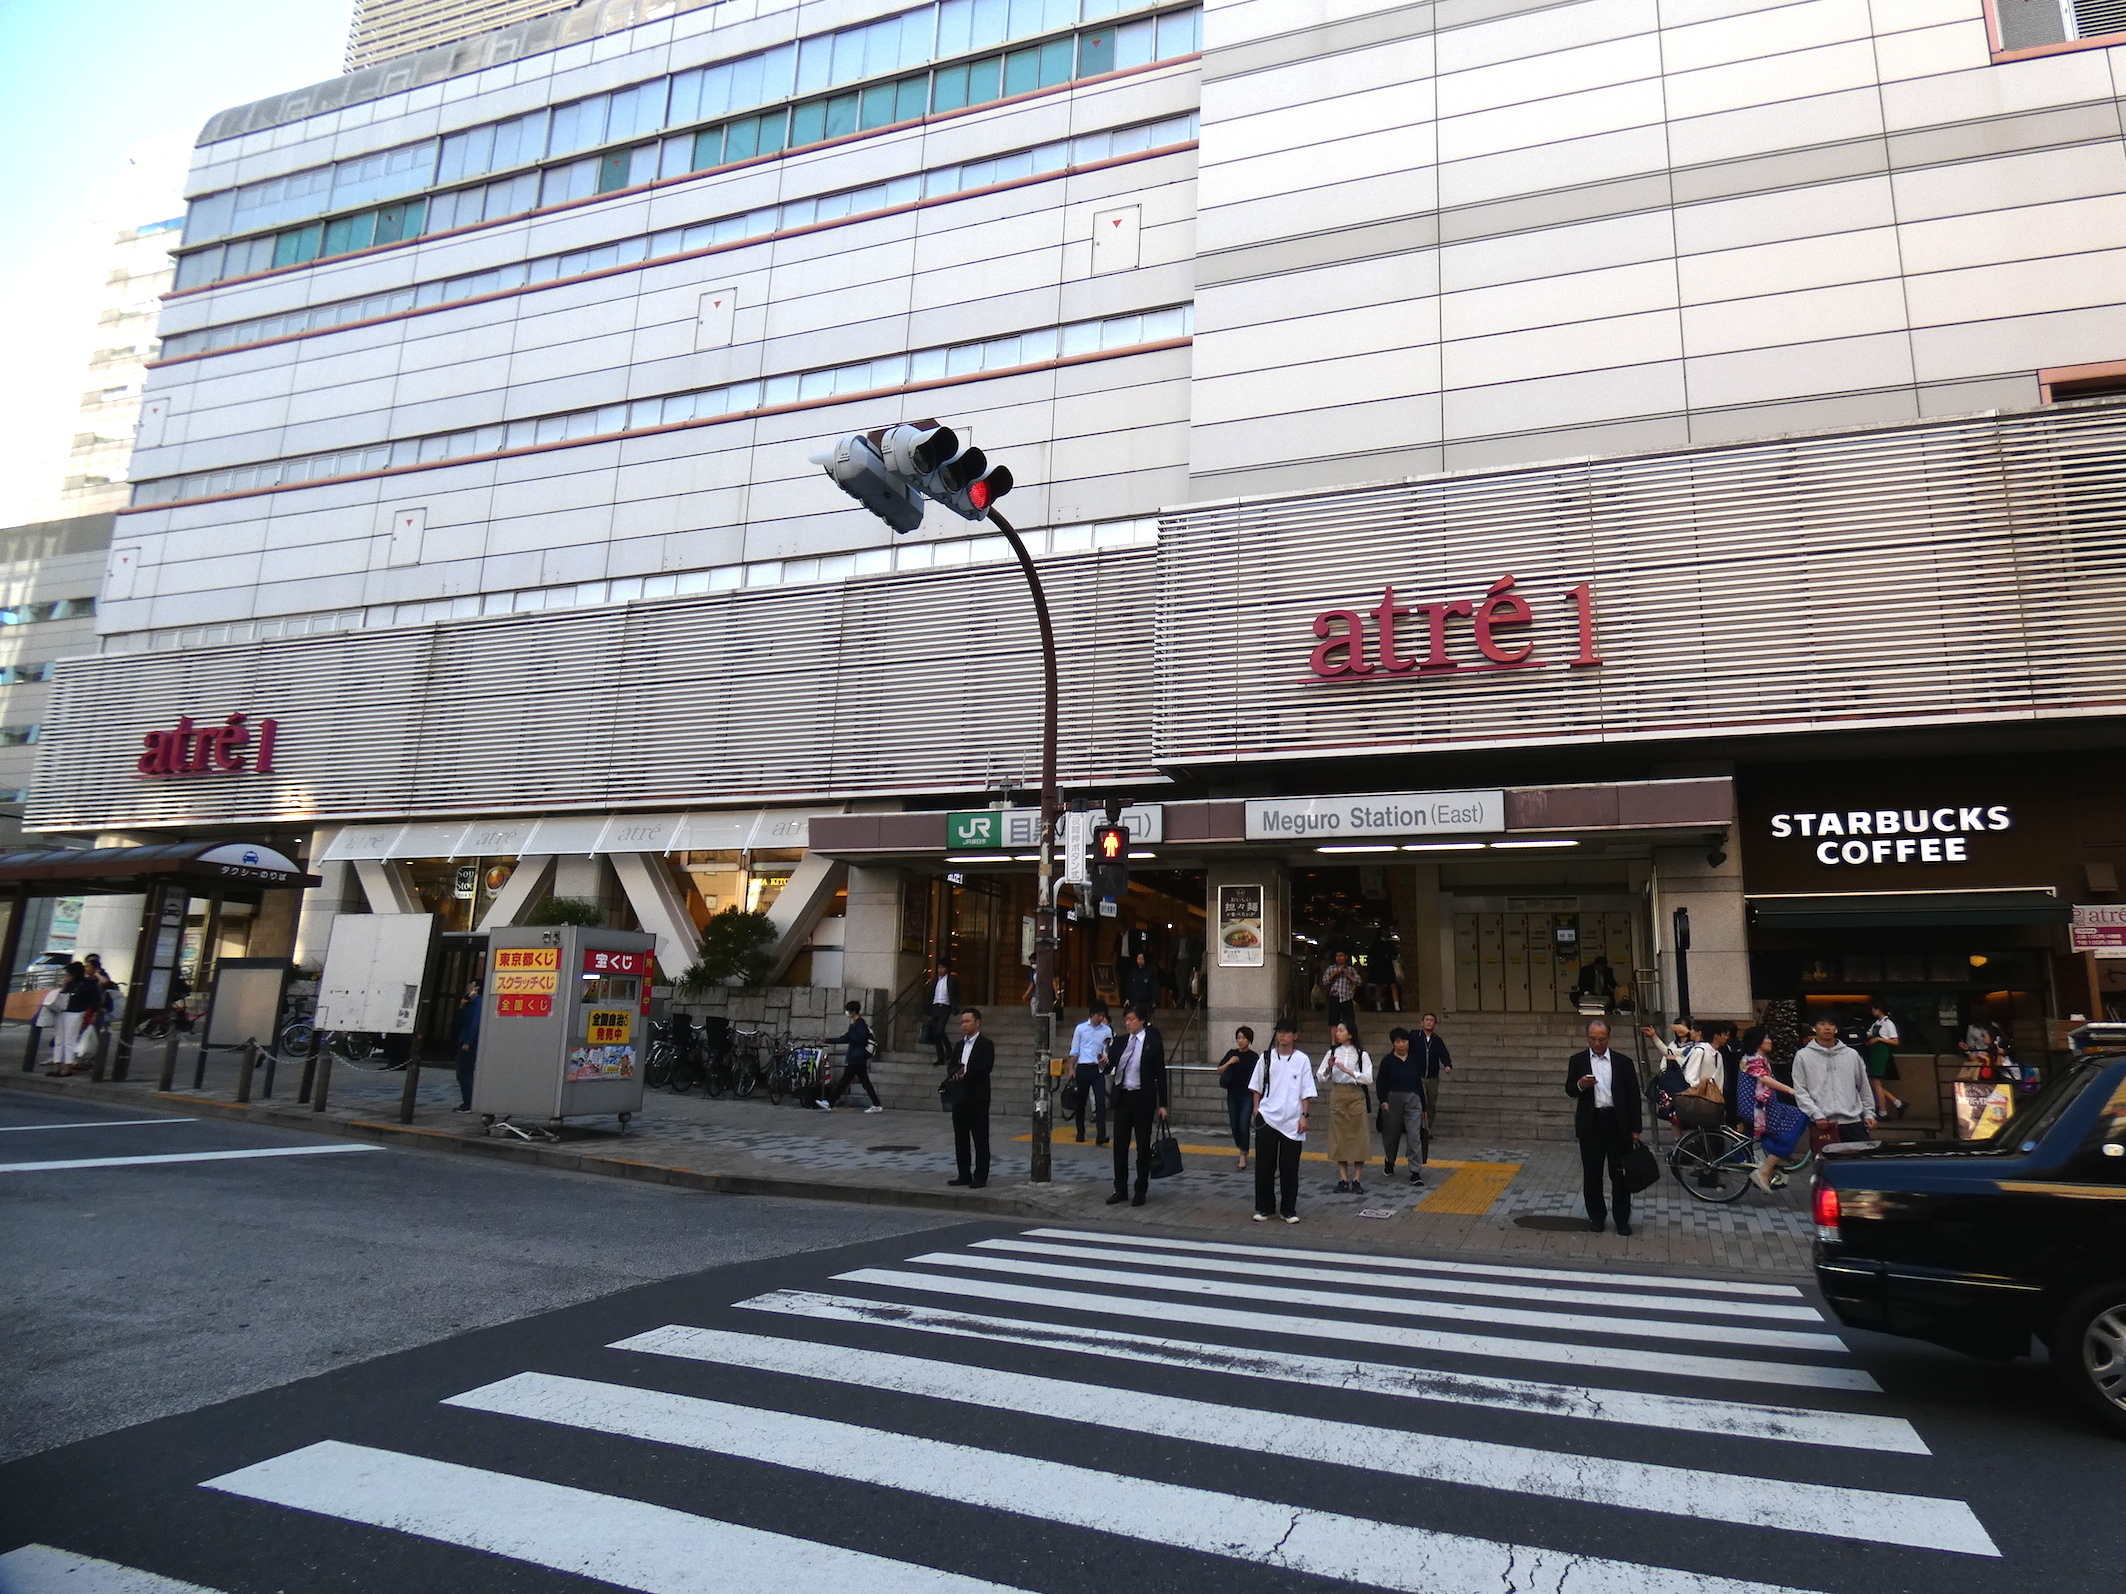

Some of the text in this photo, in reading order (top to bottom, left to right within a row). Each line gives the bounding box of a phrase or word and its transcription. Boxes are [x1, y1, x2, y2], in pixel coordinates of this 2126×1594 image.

[1309, 574, 1603, 678] atré 1
[137, 711, 250, 775] atré
[1262, 801, 1484, 834] Meguro Station (East)
[1770, 805, 2011, 838] STARBUCKS
[617, 822, 662, 842] atré
[958, 817, 991, 839] JR
[962, 838, 987, 846] JR東日本
[1070, 816, 1081, 880] 夜間押ボタン式
[1816, 837, 1968, 865] COFFEE
[220, 865, 288, 882] タクシーのりば
[1225, 902, 1259, 912] 担々麺
[499, 952, 554, 967] 東京都くじ
[595, 953, 633, 970] 宝くじ
[497, 976, 555, 990] スクラッチくじ
[642, 957, 654, 1007] 発売中
[501, 999, 548, 1011] 全国くじ
[596, 1028, 623, 1041] 発売中
